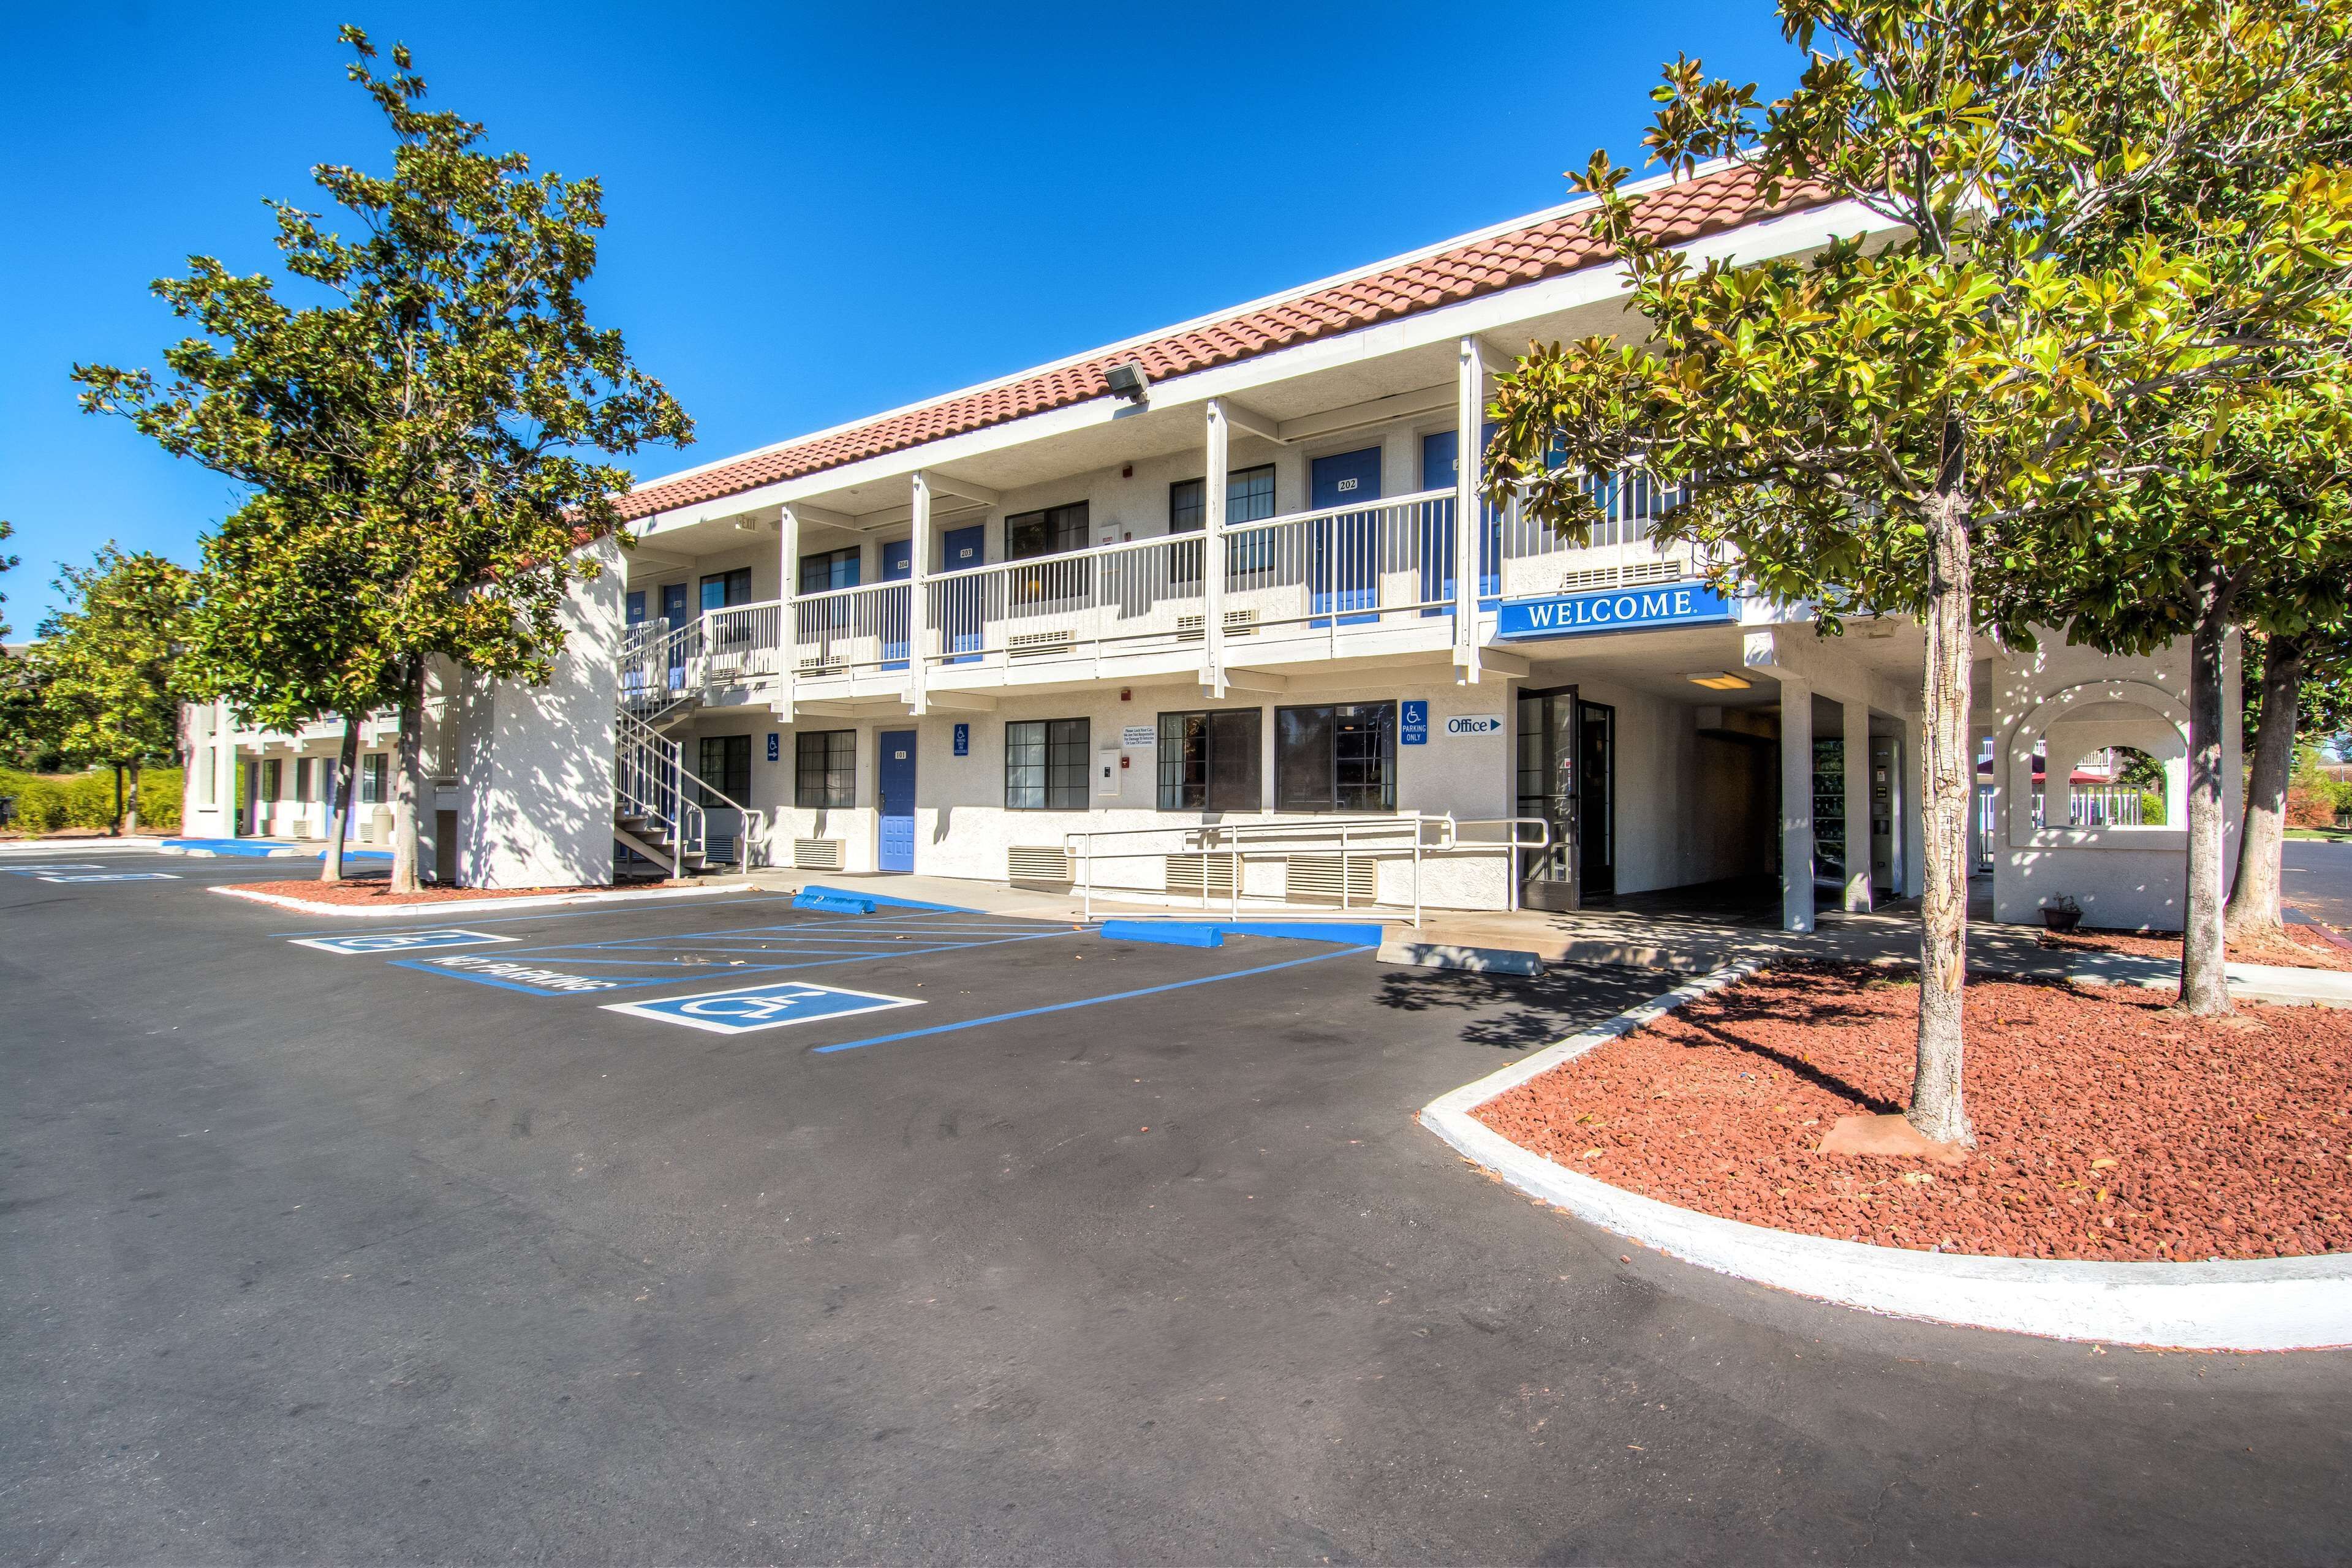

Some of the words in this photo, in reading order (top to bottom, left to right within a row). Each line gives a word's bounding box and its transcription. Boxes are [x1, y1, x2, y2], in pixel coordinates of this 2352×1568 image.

[1340, 480, 1355, 490] 202
[1527, 590, 1692, 628] WELCOME
[1448, 718, 1488, 733] Office
[463, 962, 618, 990] PARKING
